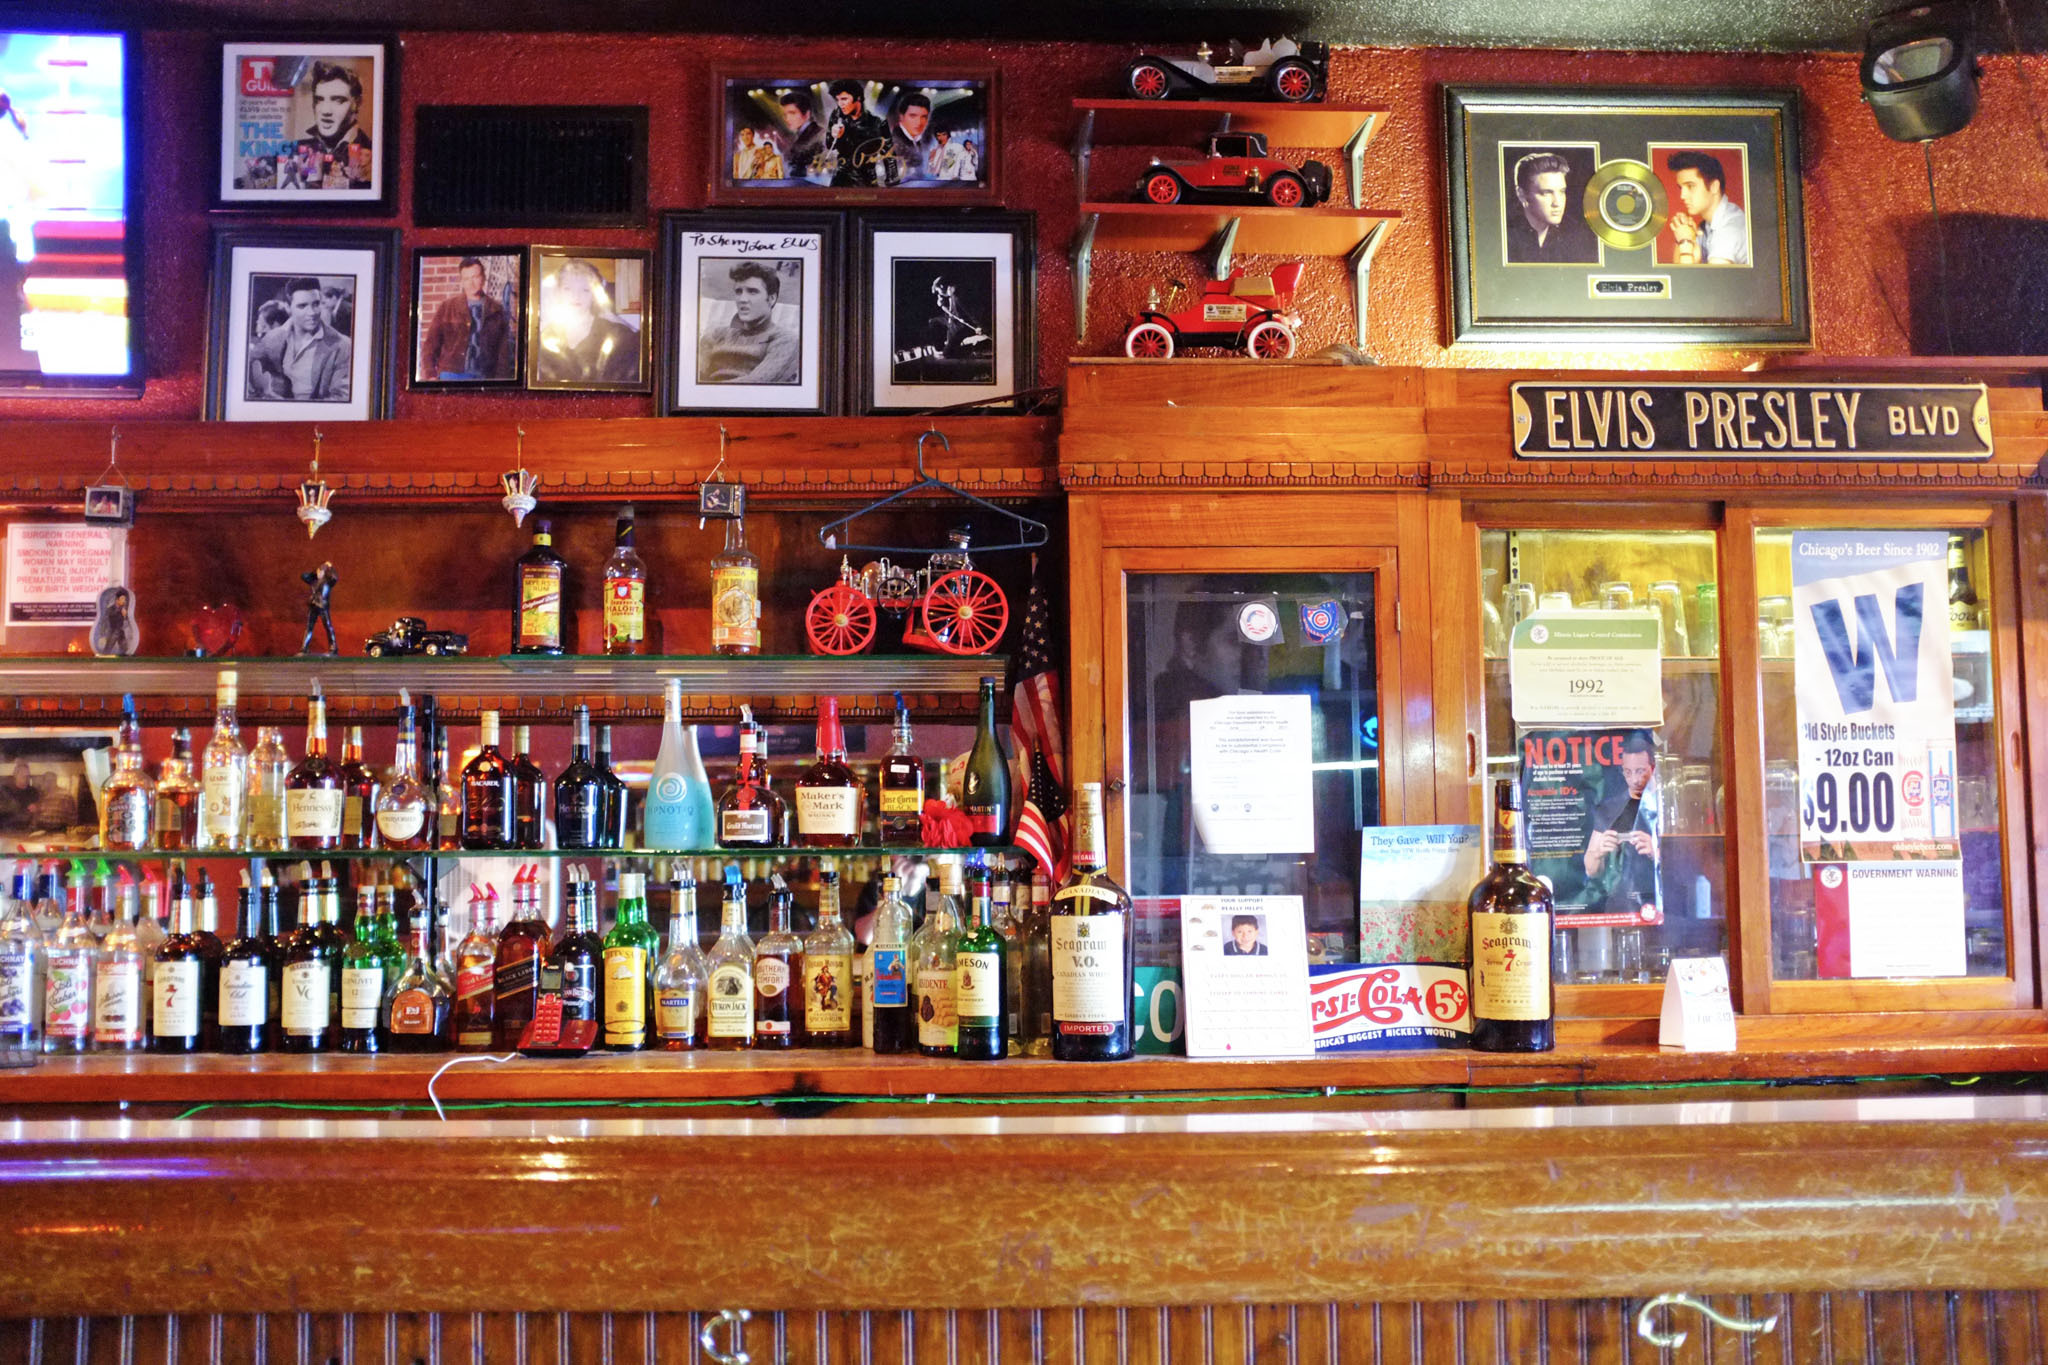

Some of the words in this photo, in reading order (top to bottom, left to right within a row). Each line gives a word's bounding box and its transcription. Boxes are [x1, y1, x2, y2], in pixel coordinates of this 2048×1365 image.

[240, 122, 284, 139] THE
[1601, 282, 1622, 292] Elvis
[1627, 282, 1659, 294] Presley
[1544, 390, 1655, 449] ELVIS
[1684, 391, 1862, 449] PRESLEY
[1888, 404, 1960, 436] BLVD
[22, 530, 62, 538] SURGEON
[17, 549, 56, 557] SMOKING
[57, 549, 68, 557] BY
[71, 549, 112, 557] PREGNAN
[1800, 542, 1854, 560] Chicago's
[1856, 543, 1880, 556] Beer
[1883, 542, 1913, 556] Since
[1916, 542, 1940, 556] 1902
[24, 558, 55, 566] WOMEN
[57, 558, 74, 566] MAY
[77, 558, 110, 566] RESULT
[16, 576, 68, 584] PREMATURE
[70, 576, 95, 584] BIRTH
[97, 576, 109, 584] AN
[1809, 582, 1924, 715] W
[1569, 679, 1604, 694] 1992
[1820, 722, 1848, 742] Style
[1850, 722, 1896, 741] Buckets
[1524, 736, 1624, 768] NOTICE
[1824, 748, 1859, 767] 12oz
[1864, 748, 1894, 766] Can
[800, 792, 845, 800] Maker's
[292, 804, 332, 813] Hennessy
[812, 802, 844, 810] Mark
[1803, 772, 1894, 834] $9.00
[1502, 810, 1510, 824] 7
[1371, 835, 1394, 847] They
[1426, 834, 1445, 844] Will
[1448, 833, 1470, 844] You?
[1852, 868, 1912, 878] GOVERNMENT
[1916, 868, 1959, 878] WARNING
[1062, 886, 1107, 897] CANADIAN
[958, 958, 990, 970] MESON
[1071, 955, 1100, 968] V.O.
[1504, 952, 1517, 972] 7
[1056, 970, 1087, 978] CANADIAN
[732, 1002, 746, 1012] JACK
[1434, 984, 1465, 1020] 5¢
[1063, 1024, 1110, 1033] IMPORTED
[1348, 1030, 1383, 1044] BIGGEST
[1386, 1028, 1422, 1038] NICKEL'S
[1424, 1028, 1456, 1040] WORTH
